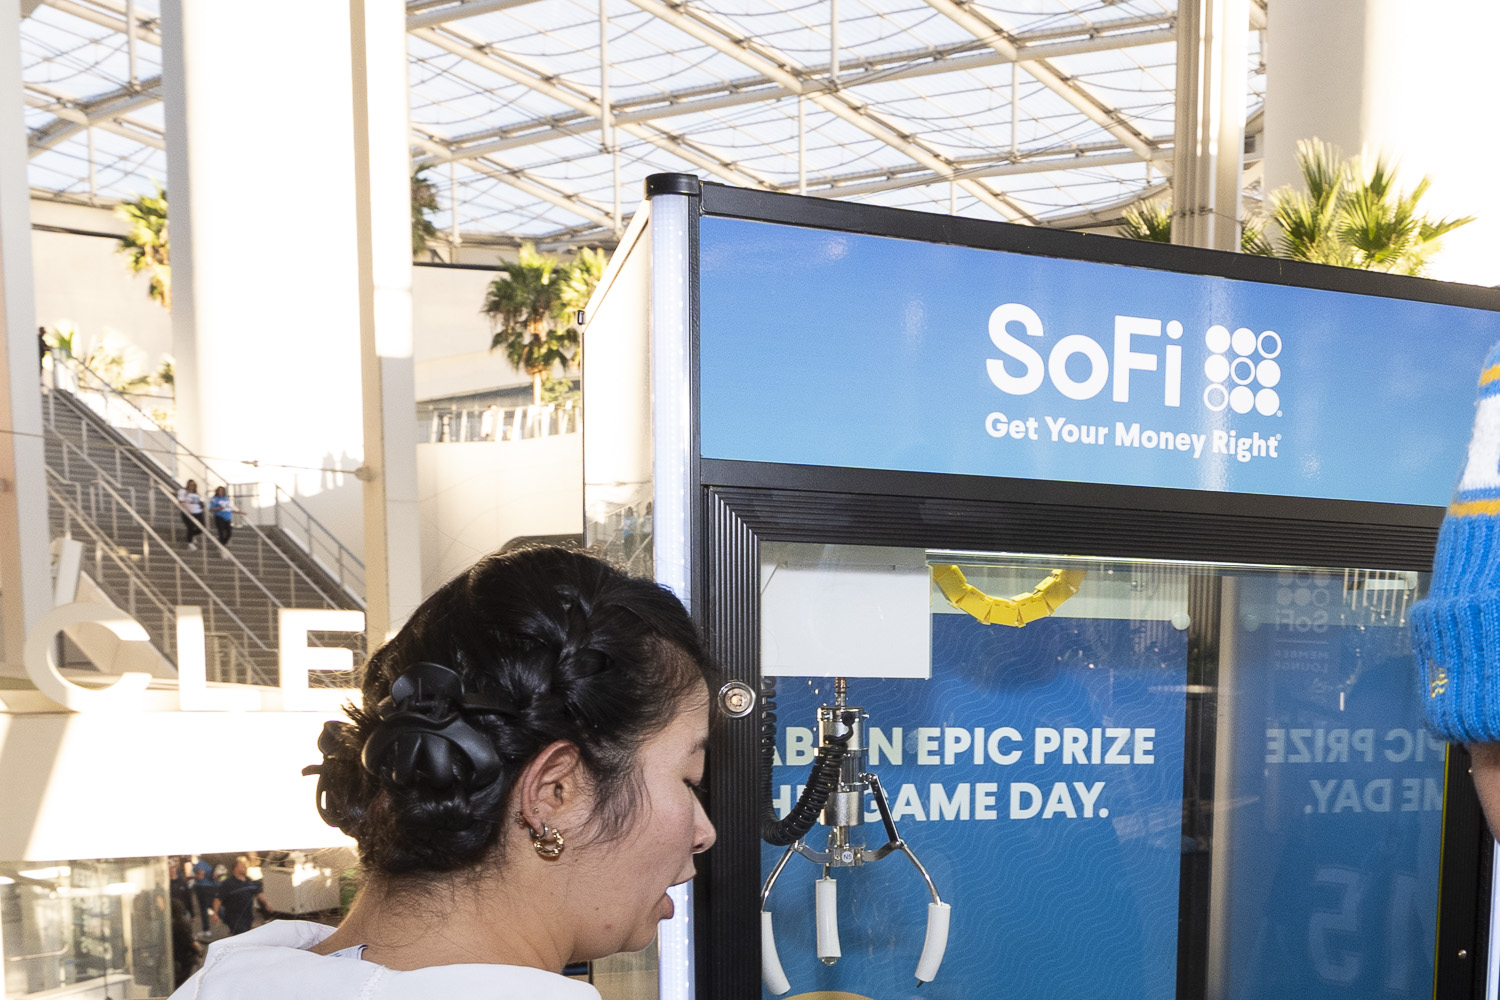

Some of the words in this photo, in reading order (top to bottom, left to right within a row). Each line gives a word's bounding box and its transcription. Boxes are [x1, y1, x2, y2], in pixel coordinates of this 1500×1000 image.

[986, 303, 1184, 407] SoFi
[985, 412, 1038, 440] Get
[1045, 416, 1108, 445] Your
[1115, 422, 1206, 458] Money
[1212, 429, 1279, 462] Right
[917, 727, 1024, 766] EPIC
[1034, 727, 1155, 765] PRIZE
[1009, 781, 1109, 820] DAY.
